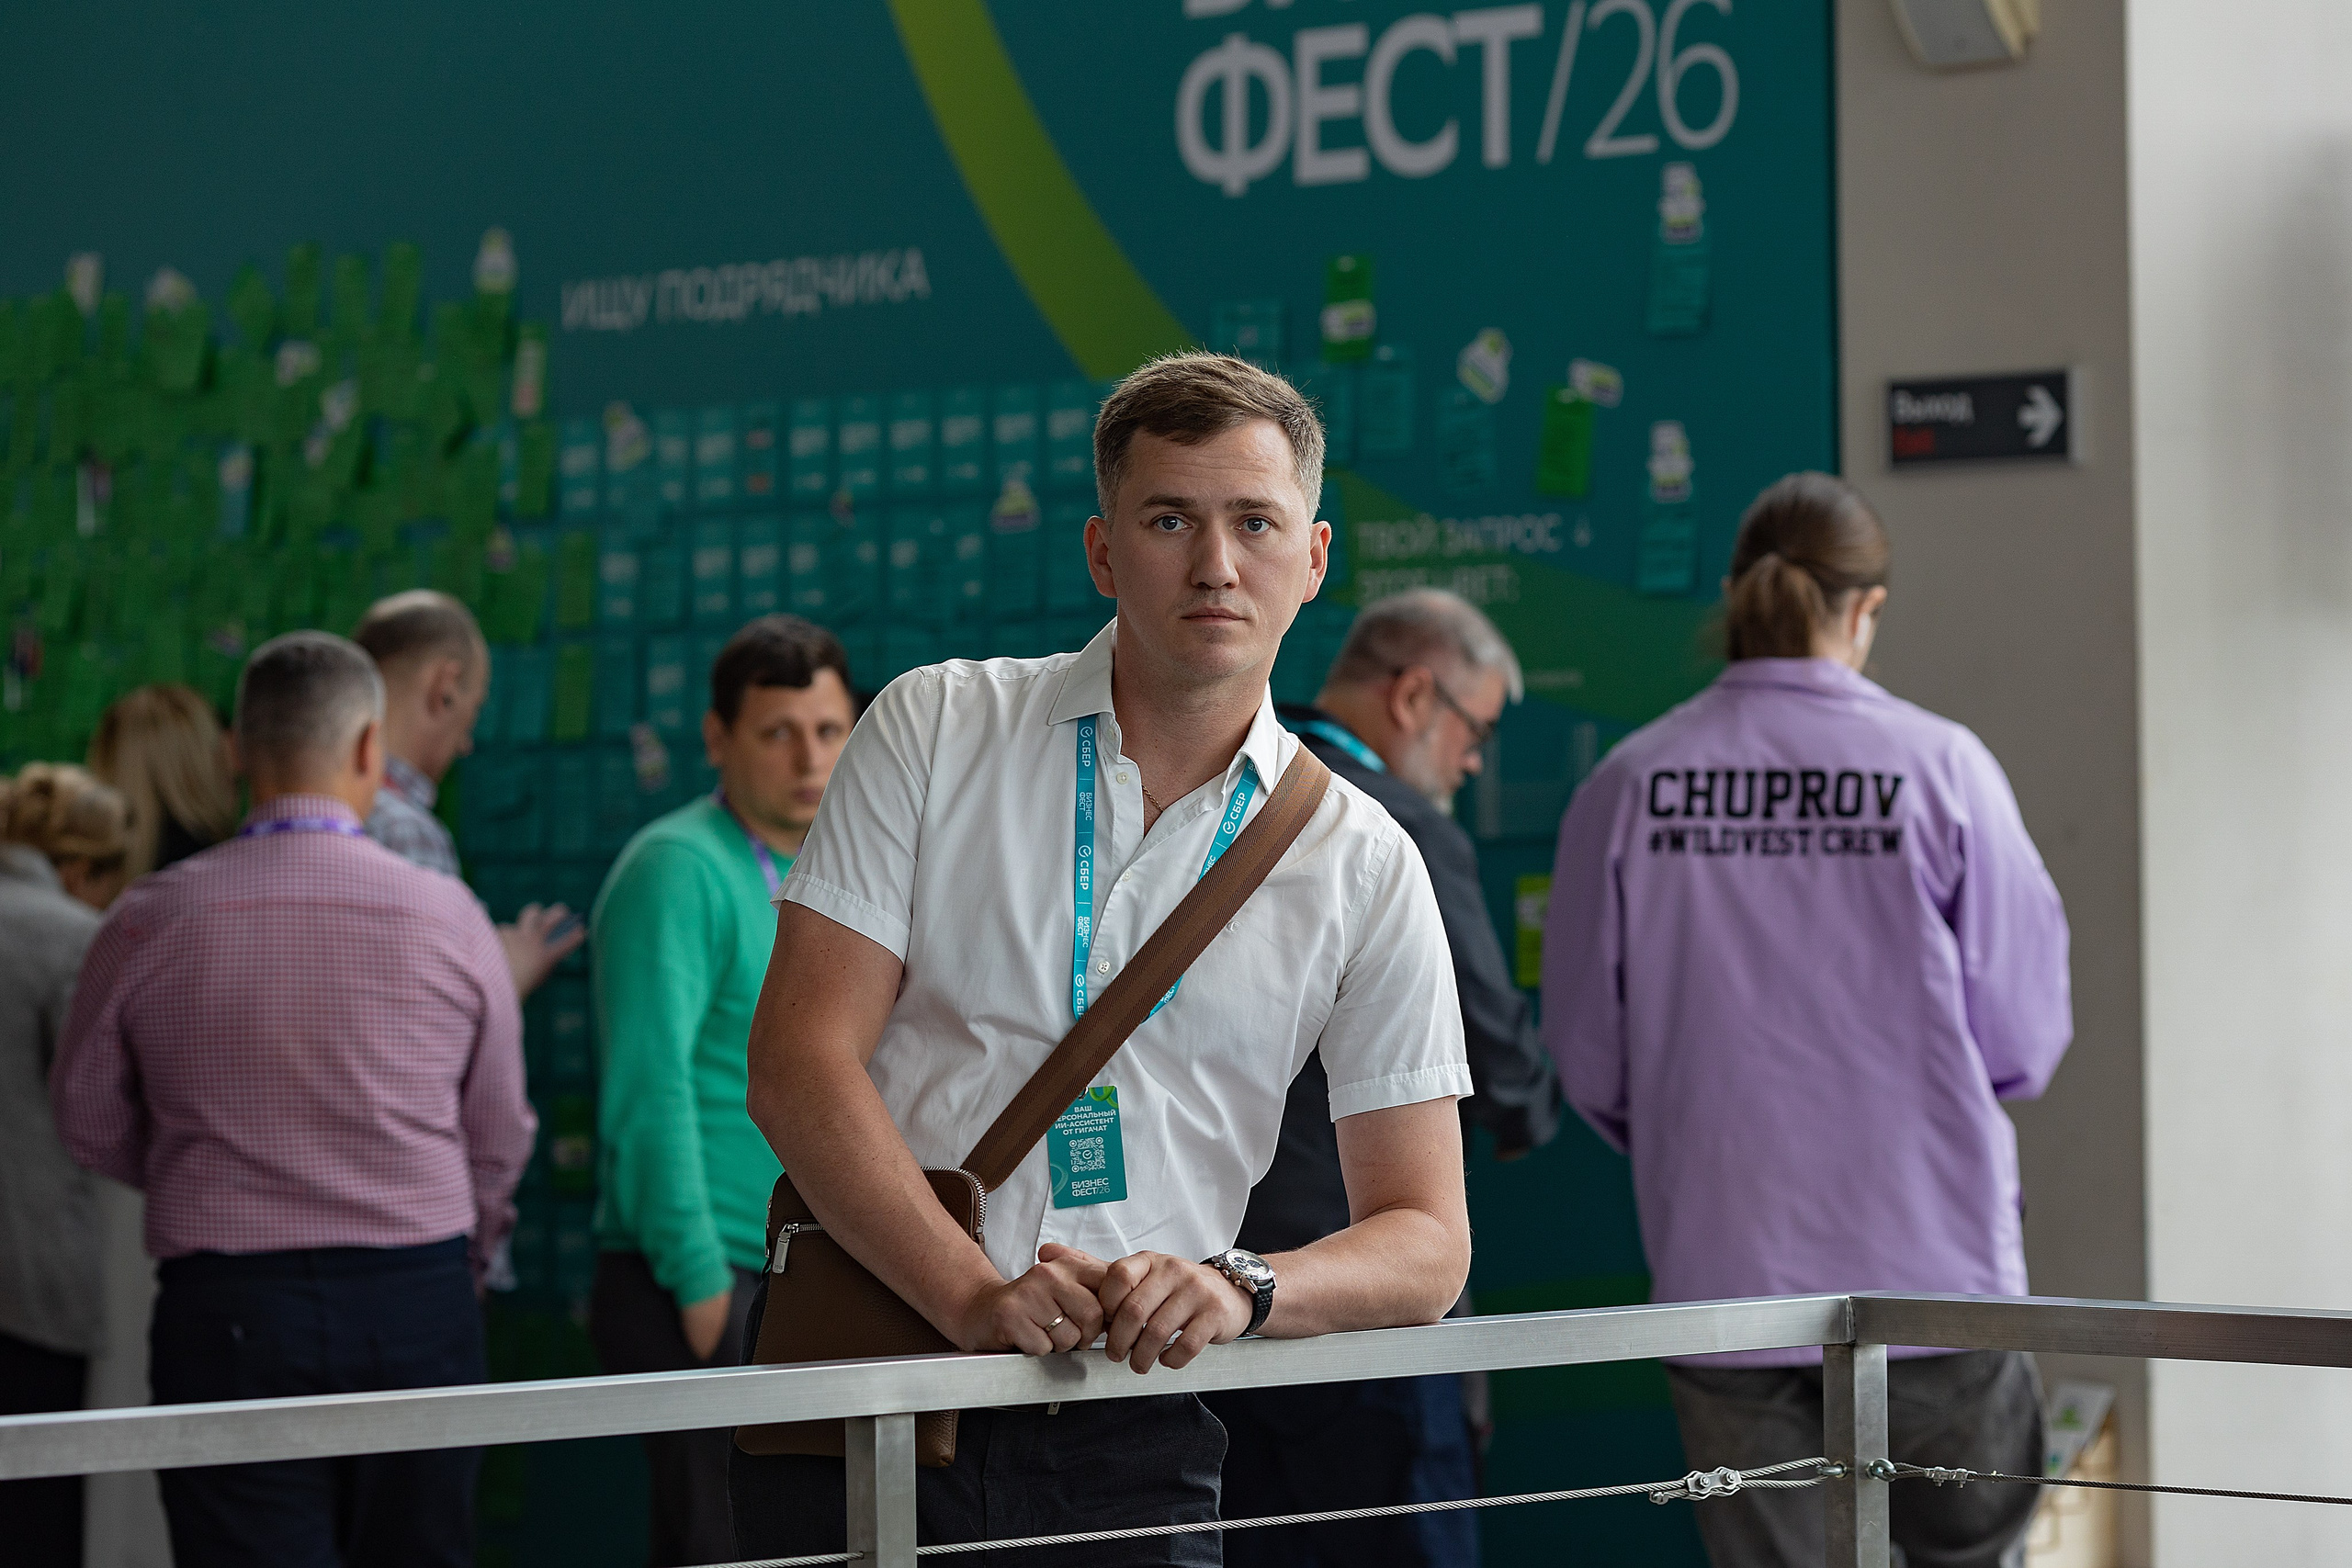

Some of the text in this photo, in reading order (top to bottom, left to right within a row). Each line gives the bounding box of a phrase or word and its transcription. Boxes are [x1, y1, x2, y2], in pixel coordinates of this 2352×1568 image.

[1174, 0, 1741, 197] ФЕСТ/26
[561, 246, 932, 332] ИЩУ ПОДРЯДЧИКА
[1081, 739, 1091, 767] СБЕР
[1229, 792, 1246, 820] СБЕР
[1650, 770, 1903, 818] CHUPROV
[1080, 860, 1089, 890] СБЕР
[1082, 917, 1091, 948] БИЗНЕС
[1057, 1109, 1116, 1122] ЕРСОНАЛЬНЫЙ
[1074, 1105, 1092, 1113] ВАШ
[1055, 1117, 1114, 1130] ИИ-АССИСТЕНТ
[1074, 1124, 1108, 1134] ГИГАЧАТ
[1071, 1178, 1110, 1190] БИЗНЕС
[1071, 1185, 1111, 1197] ФЕСТ/26
